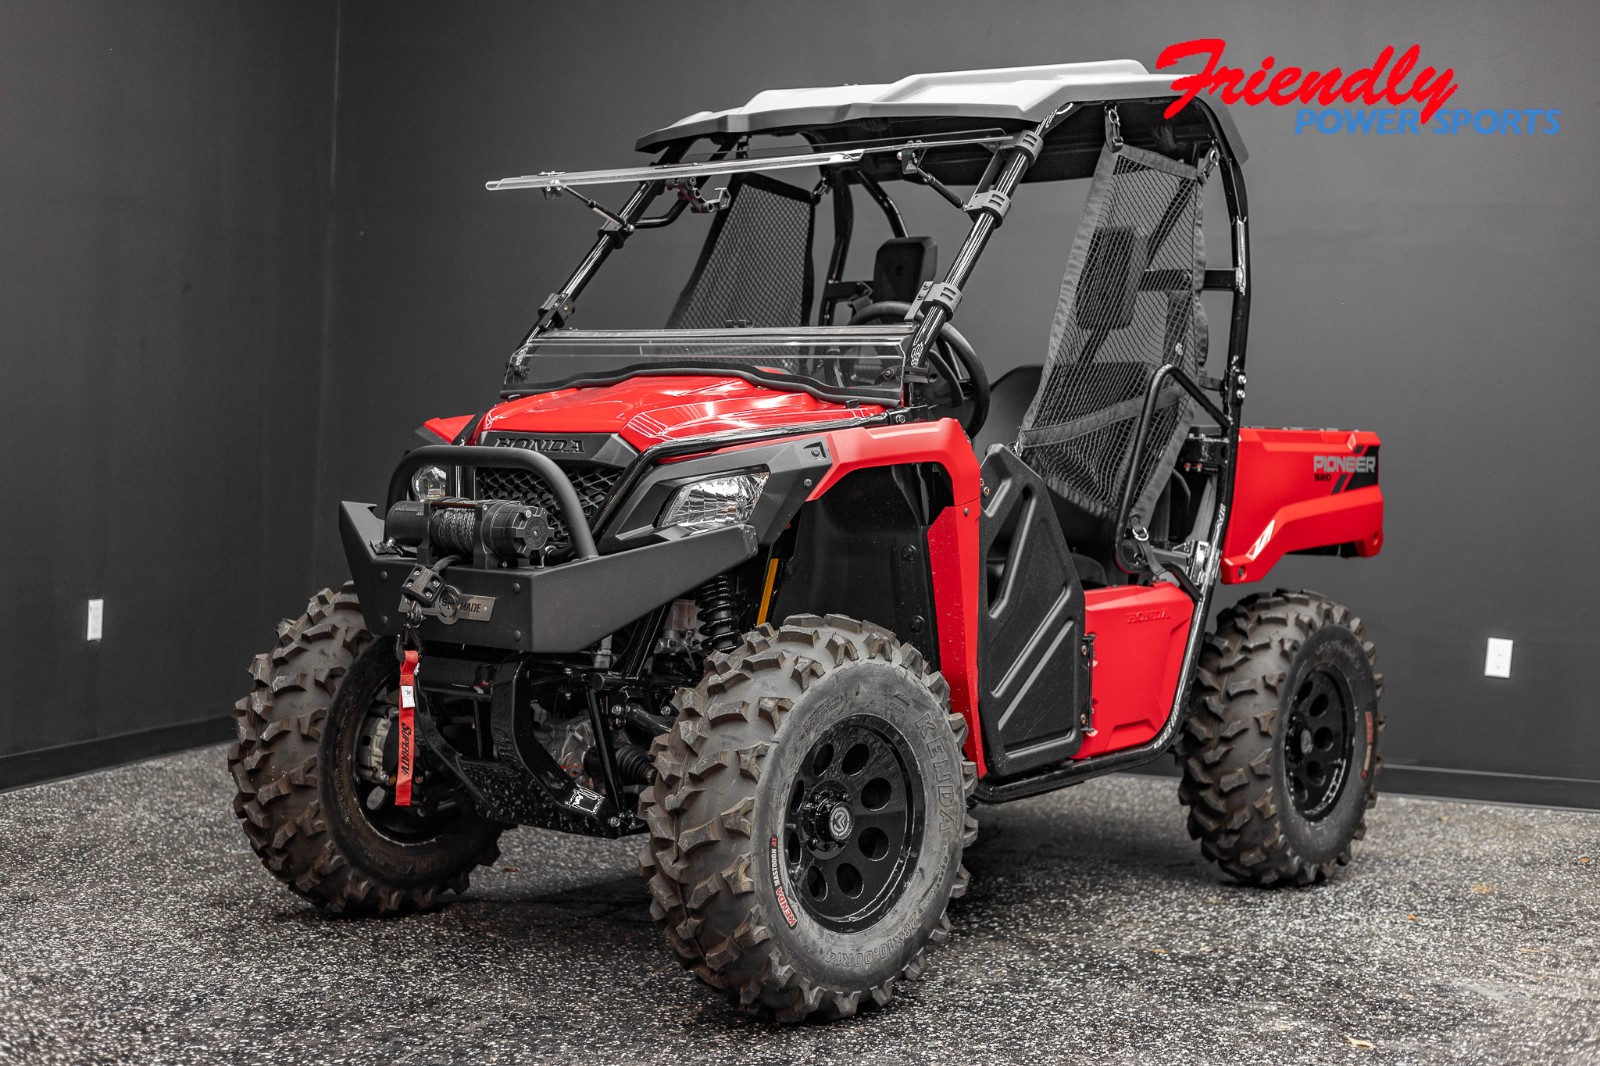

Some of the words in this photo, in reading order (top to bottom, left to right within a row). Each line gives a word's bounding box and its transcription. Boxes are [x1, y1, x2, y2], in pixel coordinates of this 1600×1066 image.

[494, 438, 585, 453] HONDA
[1313, 455, 1377, 473] PIONEER
[460, 602, 481, 613] MADE
[1126, 608, 1171, 624] HONDA
[914, 712, 955, 832] KENDA
[771, 848, 781, 887] MASTODON
[776, 886, 797, 927] KENDA
